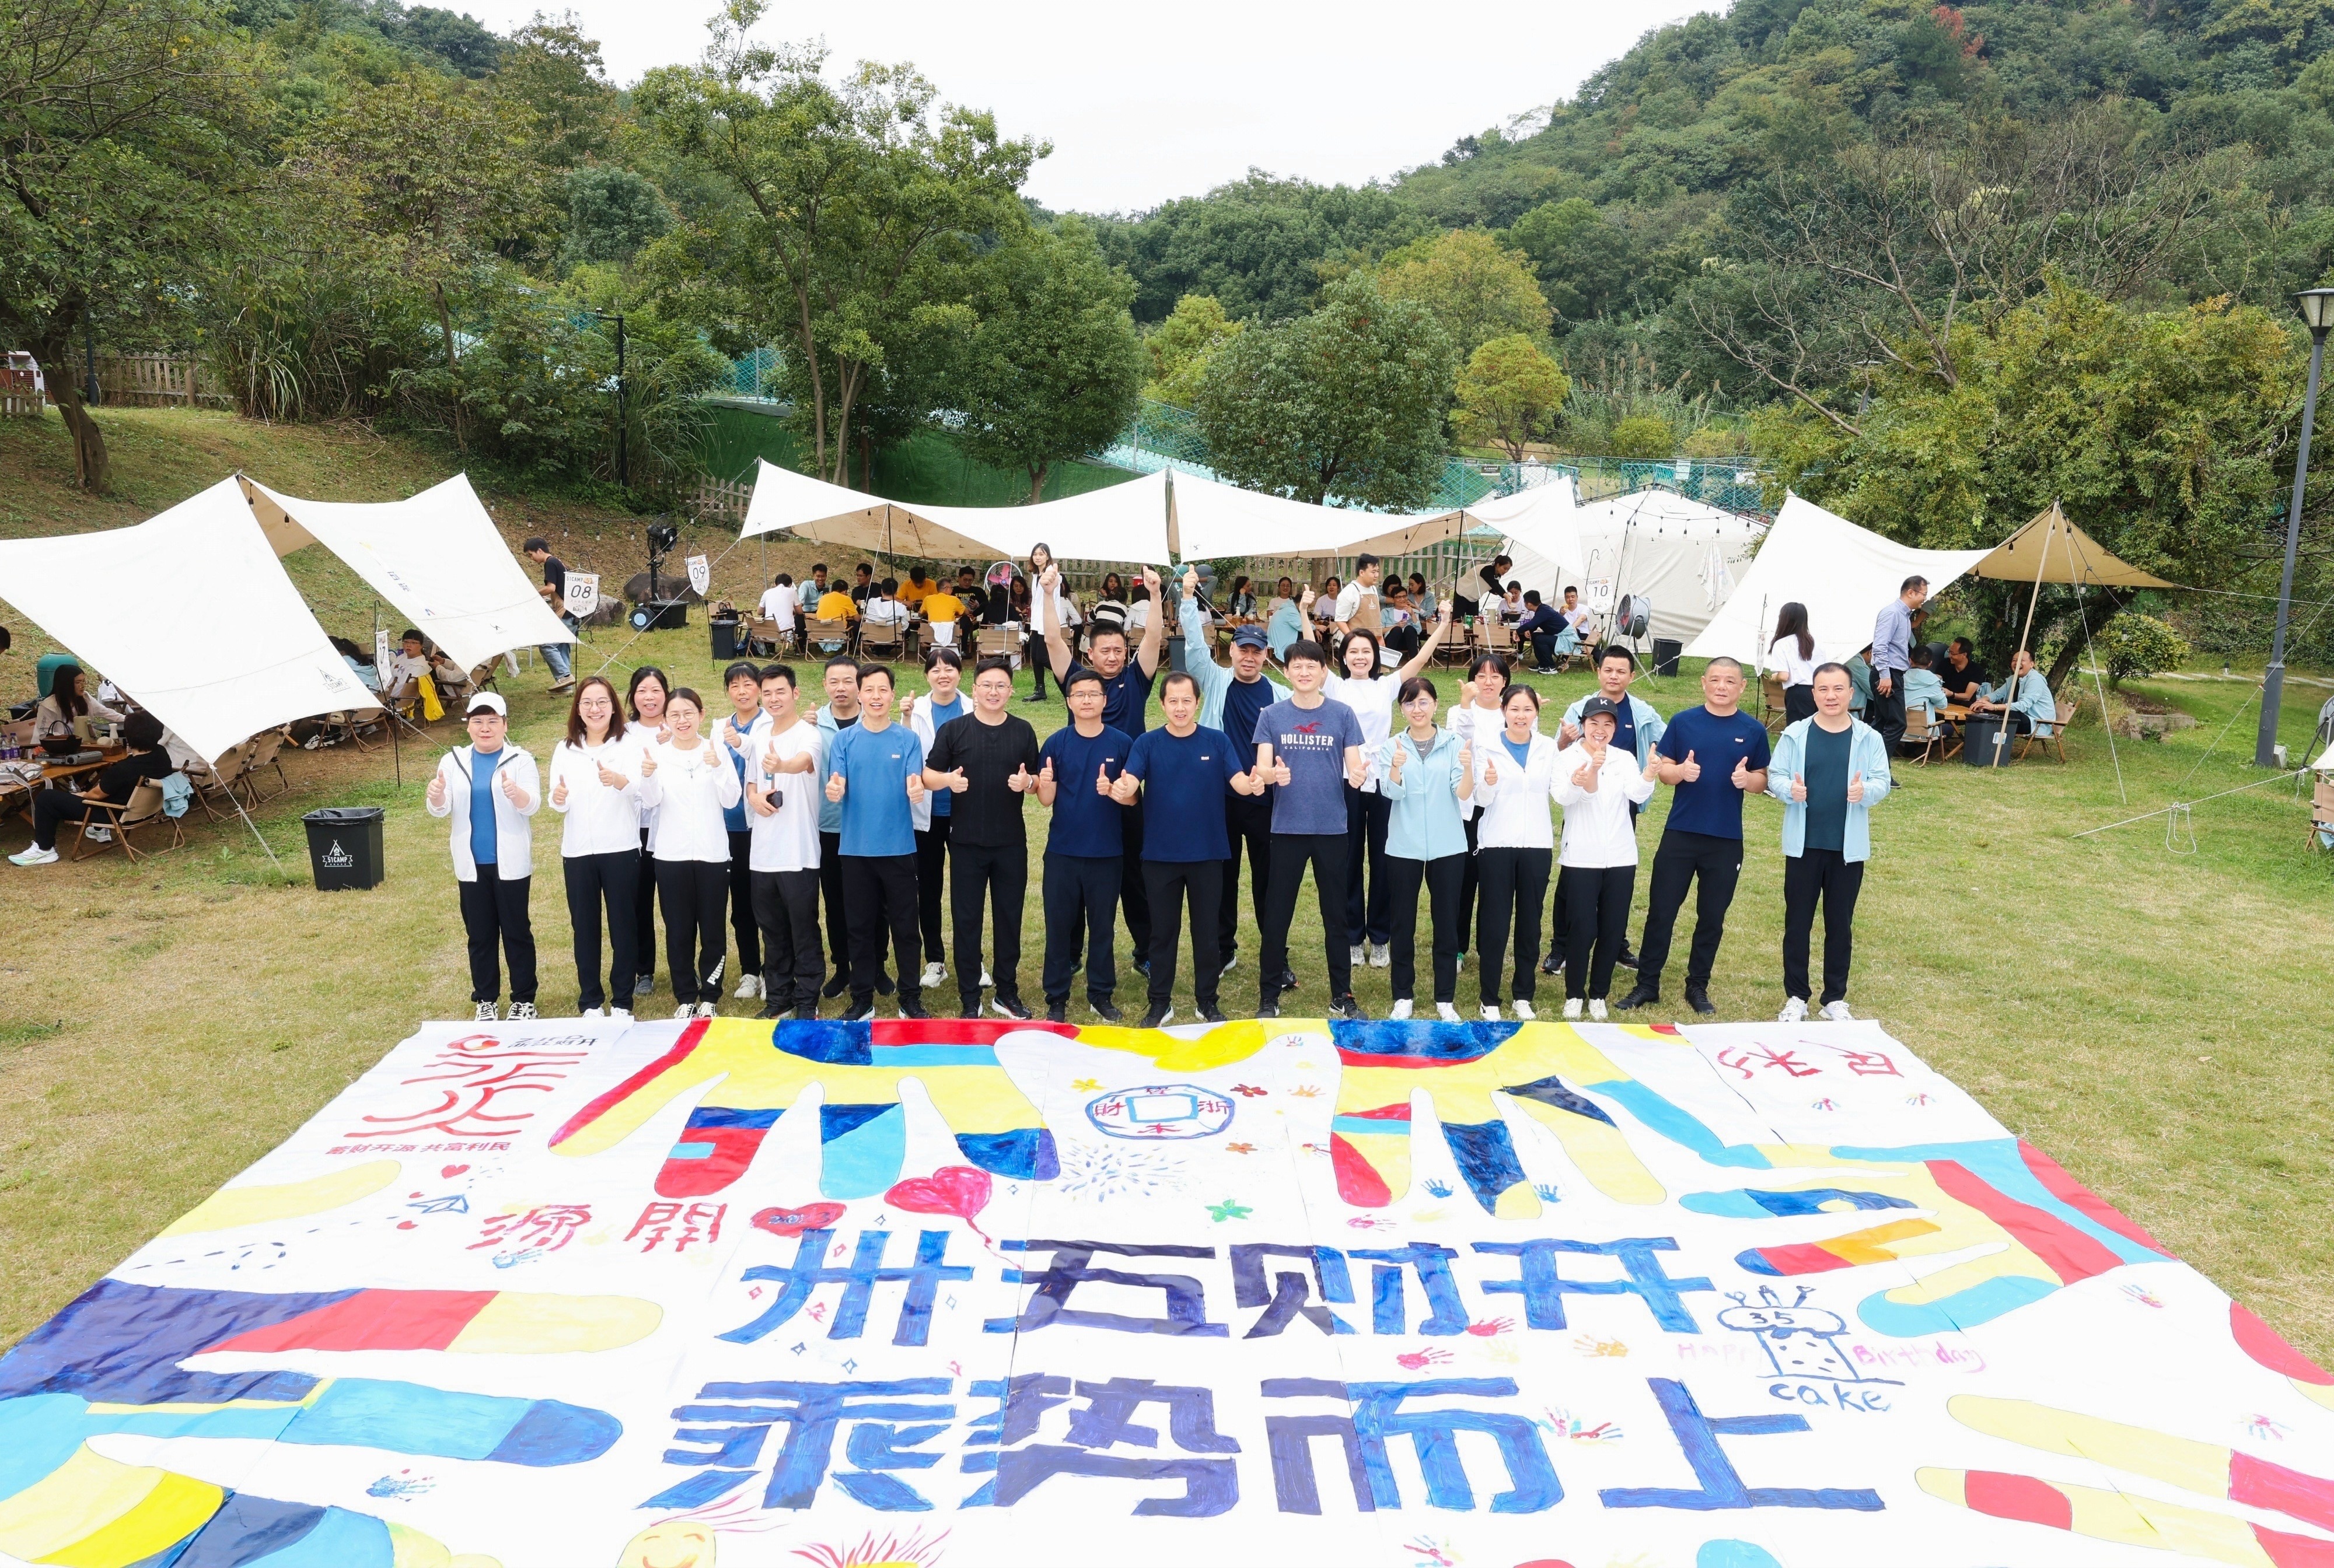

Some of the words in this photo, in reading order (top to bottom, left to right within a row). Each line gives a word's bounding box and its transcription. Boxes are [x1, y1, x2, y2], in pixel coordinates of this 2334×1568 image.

[693, 566, 705, 579] 09
[571, 584, 592, 599] 08
[1594, 585, 1608, 597] 10
[1280, 734, 1334, 746] HOLLISTER
[419, 1142, 512, 1153] 共富利民
[1749, 1312, 1795, 1325] 35
[1853, 1341, 1987, 1373] Birthday
[1769, 1382, 1891, 1413] cake
[637, 1372, 1886, 1517] 乘势而上
